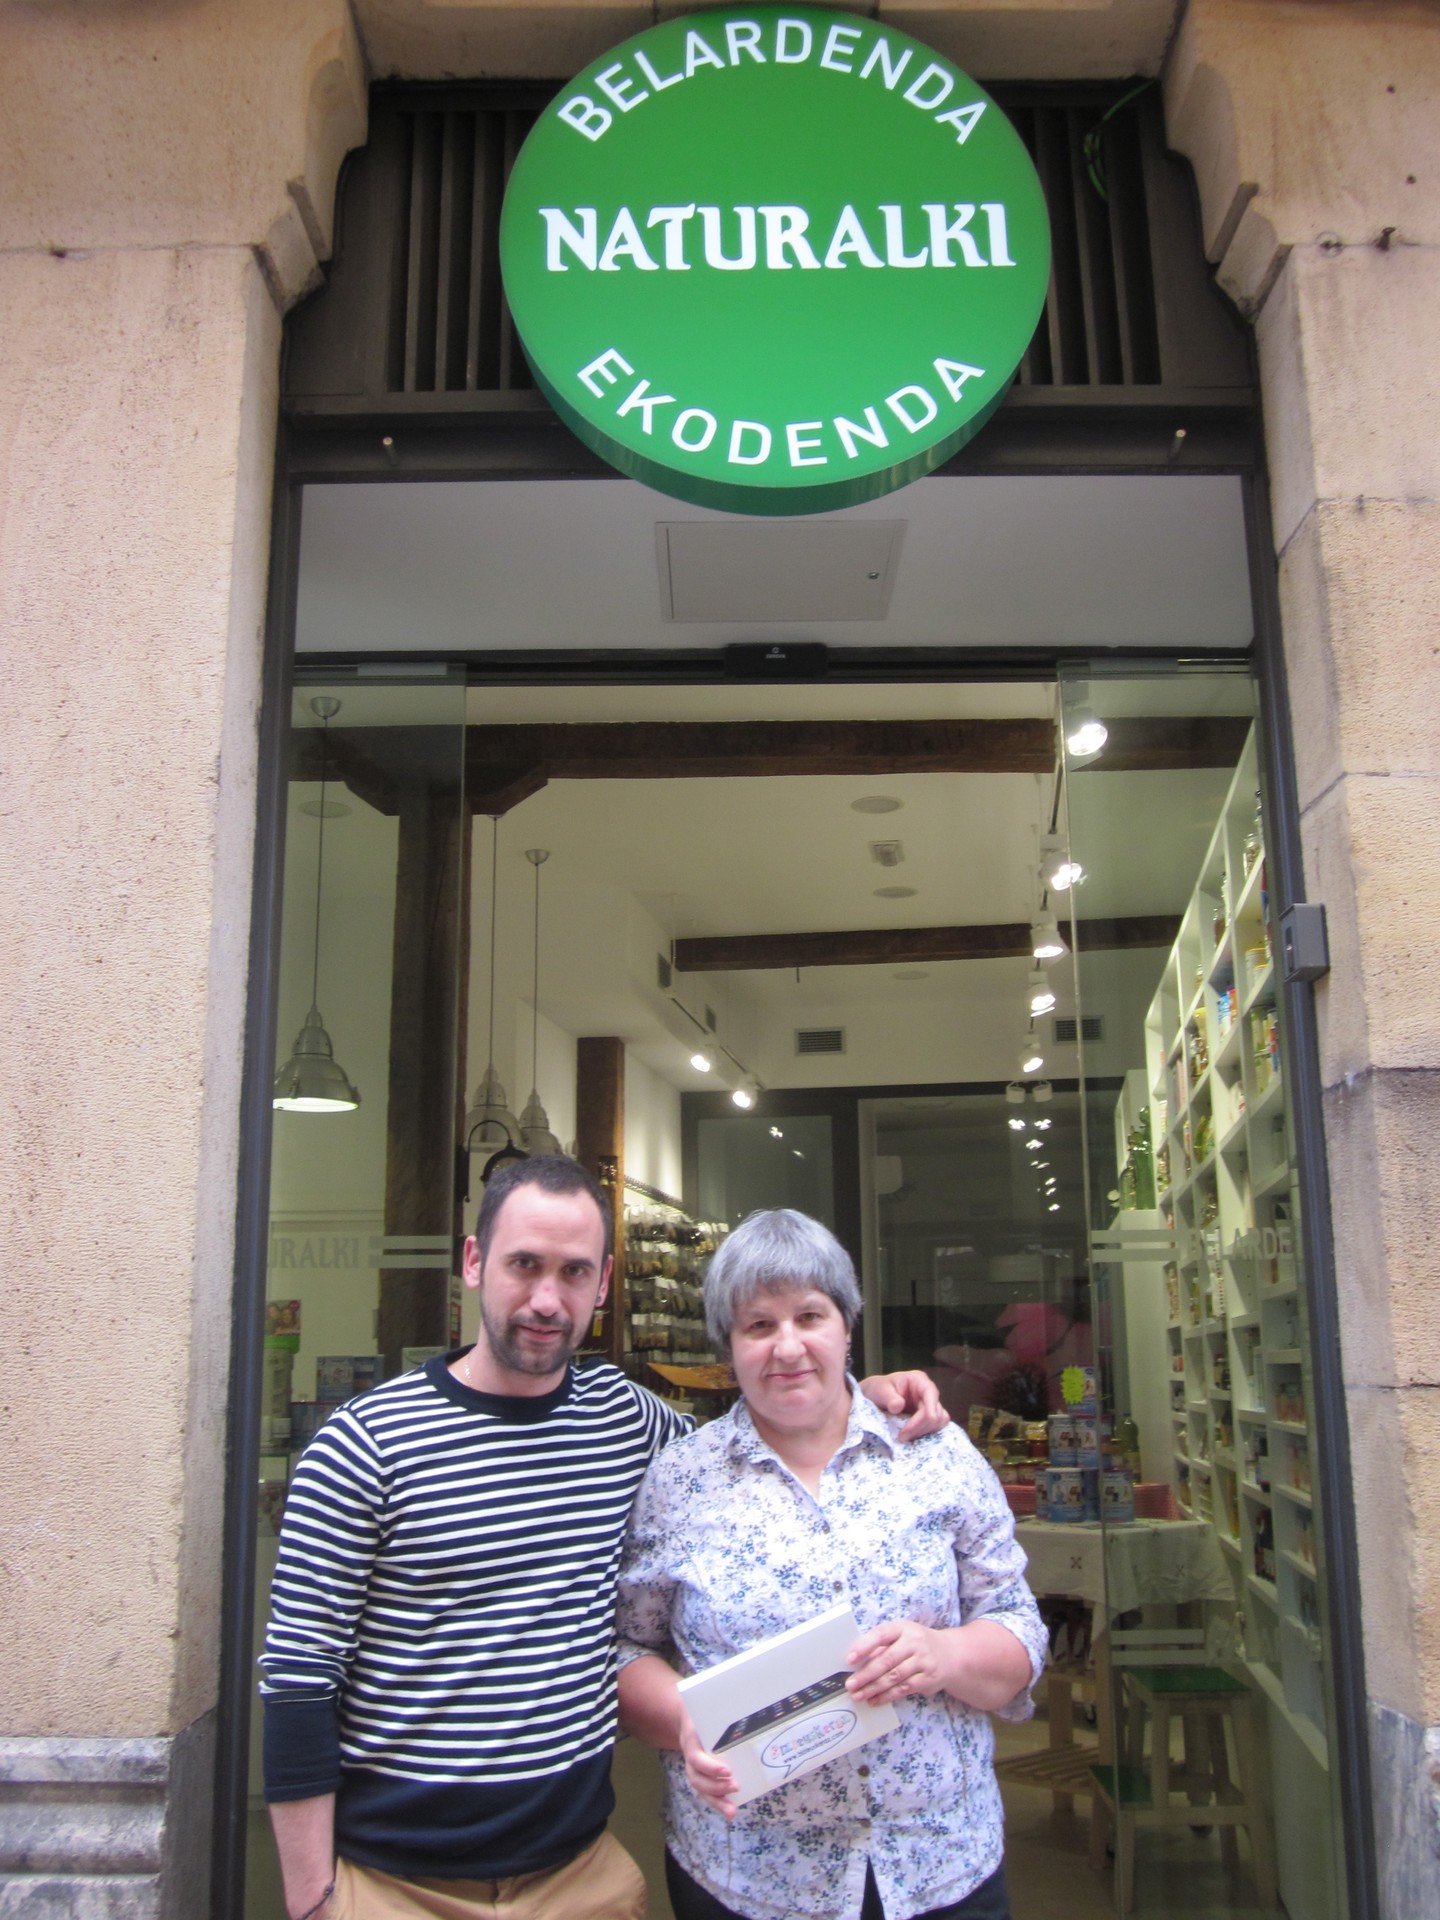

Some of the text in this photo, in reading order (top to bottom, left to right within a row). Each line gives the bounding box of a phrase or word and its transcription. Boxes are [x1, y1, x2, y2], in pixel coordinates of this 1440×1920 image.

[557, 19, 987, 145] BELARDENDA
[538, 203, 1017, 272] NATURALKI
[577, 347, 986, 467] EKODENDA
